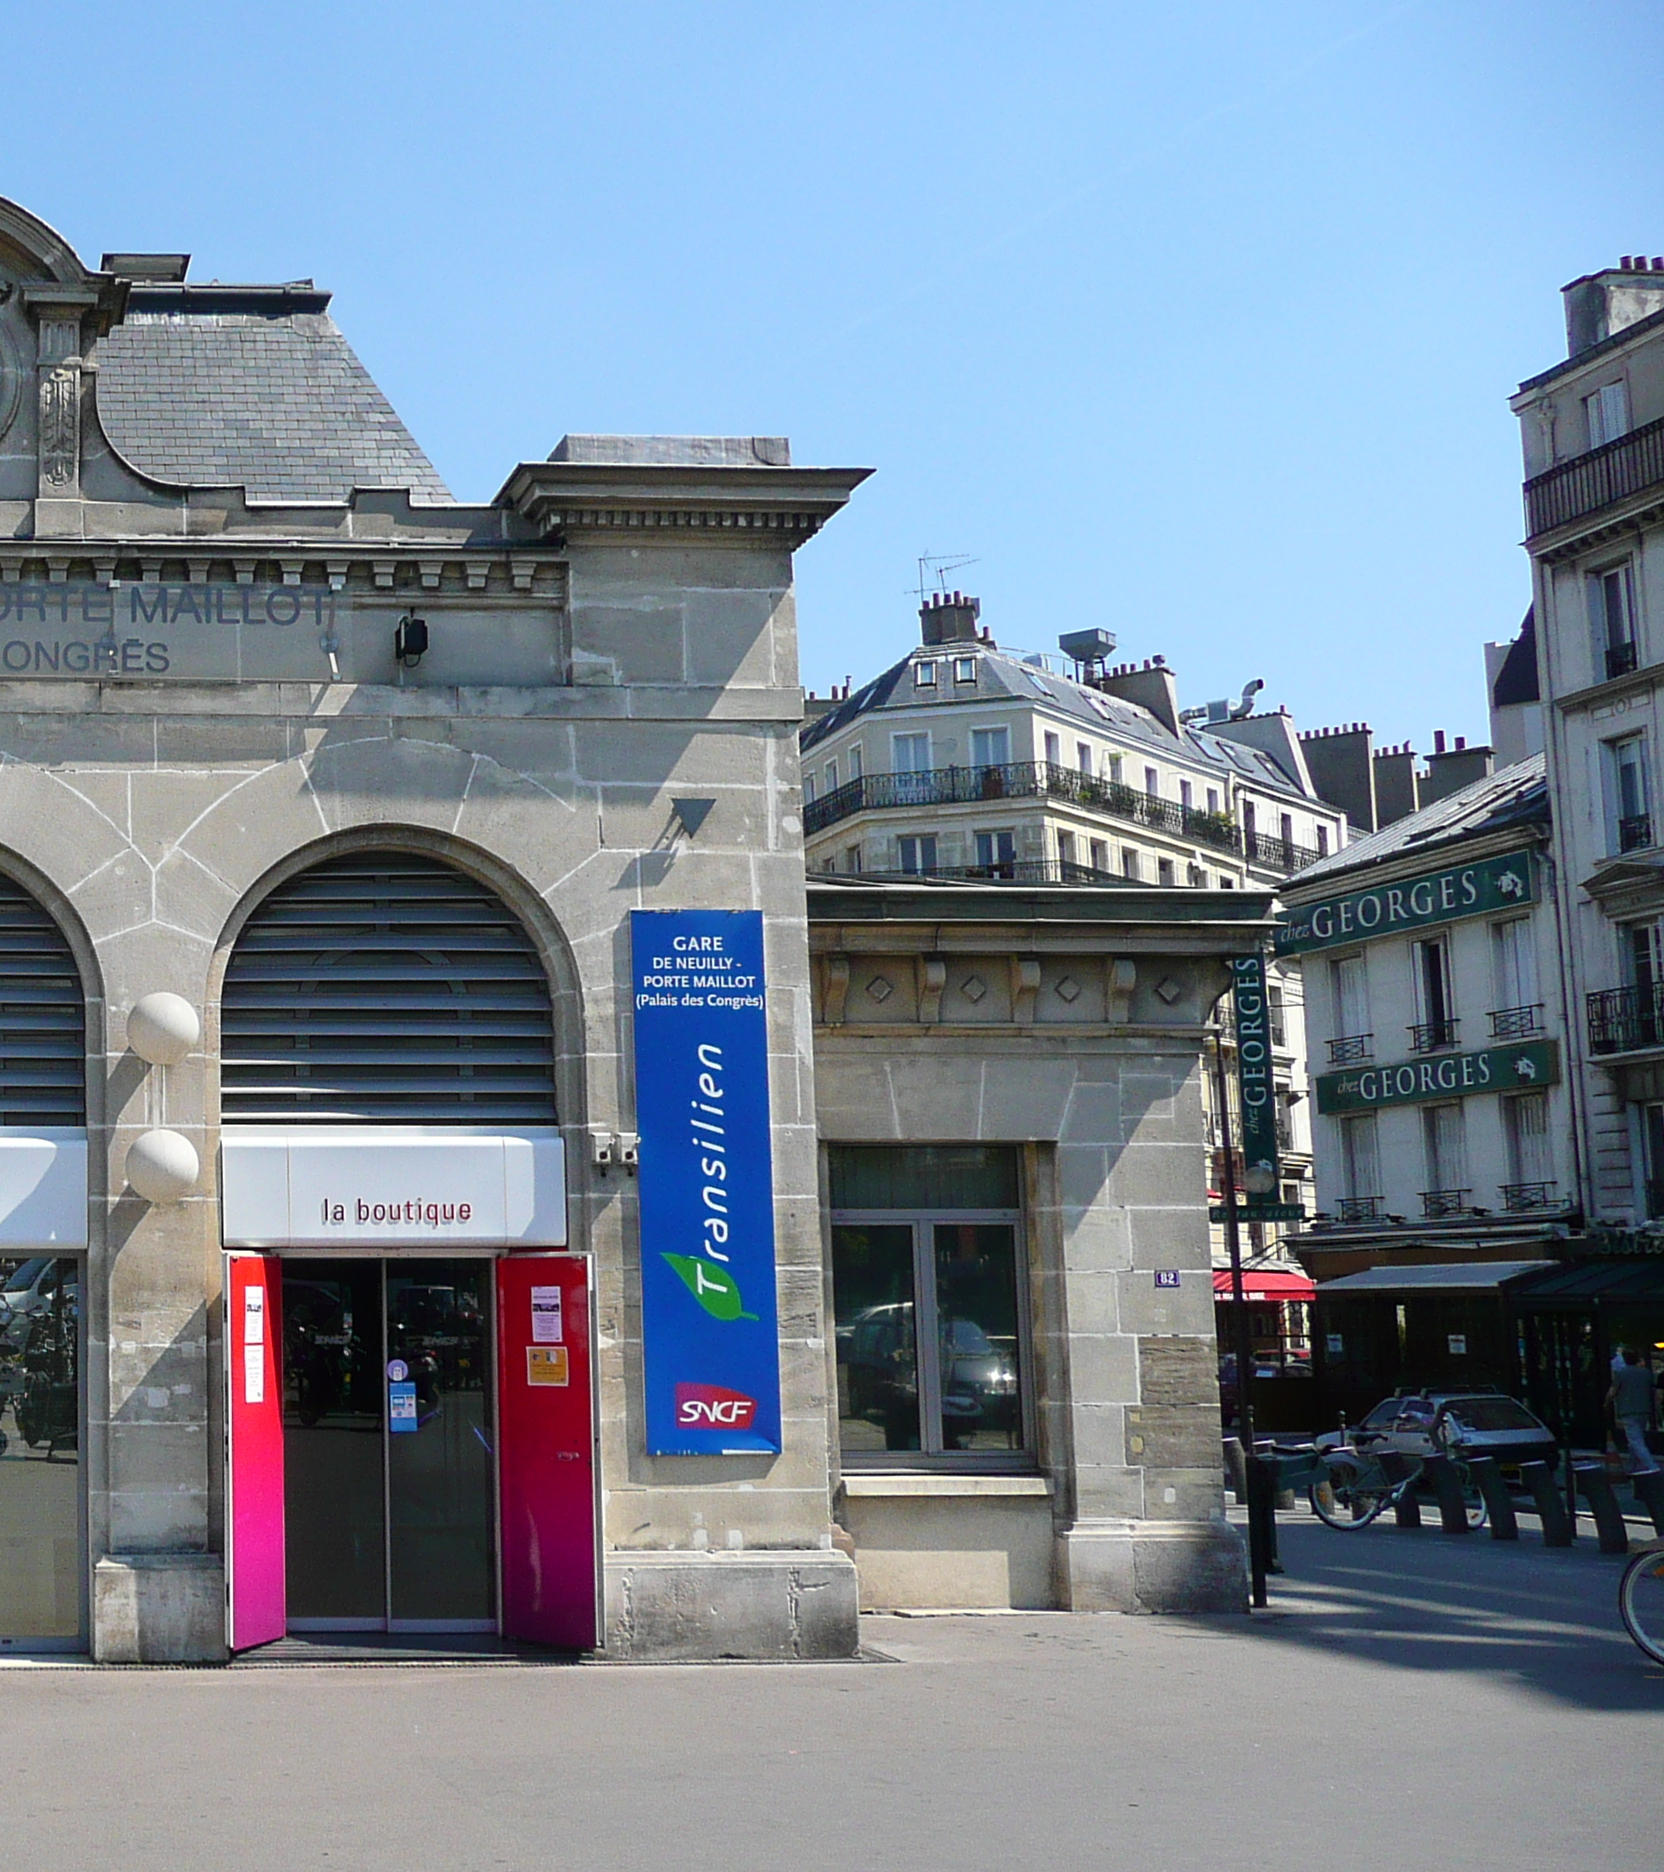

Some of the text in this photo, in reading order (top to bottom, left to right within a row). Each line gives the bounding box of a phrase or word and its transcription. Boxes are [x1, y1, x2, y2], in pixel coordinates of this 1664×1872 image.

[130, 585, 333, 626] MAILLOT
[1279, 869, 1477, 943] chez GEORGES
[672, 936, 724, 951] GARE
[652, 956, 673, 970] DE
[676, 956, 734, 970] NEUILLY
[643, 975, 756, 988] PORTE MAILLOT
[636, 993, 764, 1011] (Palais des Congrès)
[1235, 957, 1268, 1135] chez GEORGES
[1337, 1053, 1491, 1101] chez GEORGES
[691, 1042, 729, 1296] Transilien
[323, 1197, 472, 1226] la boutique
[1159, 1272, 1176, 1285] 82
[678, 1400, 753, 1423] SNCF
